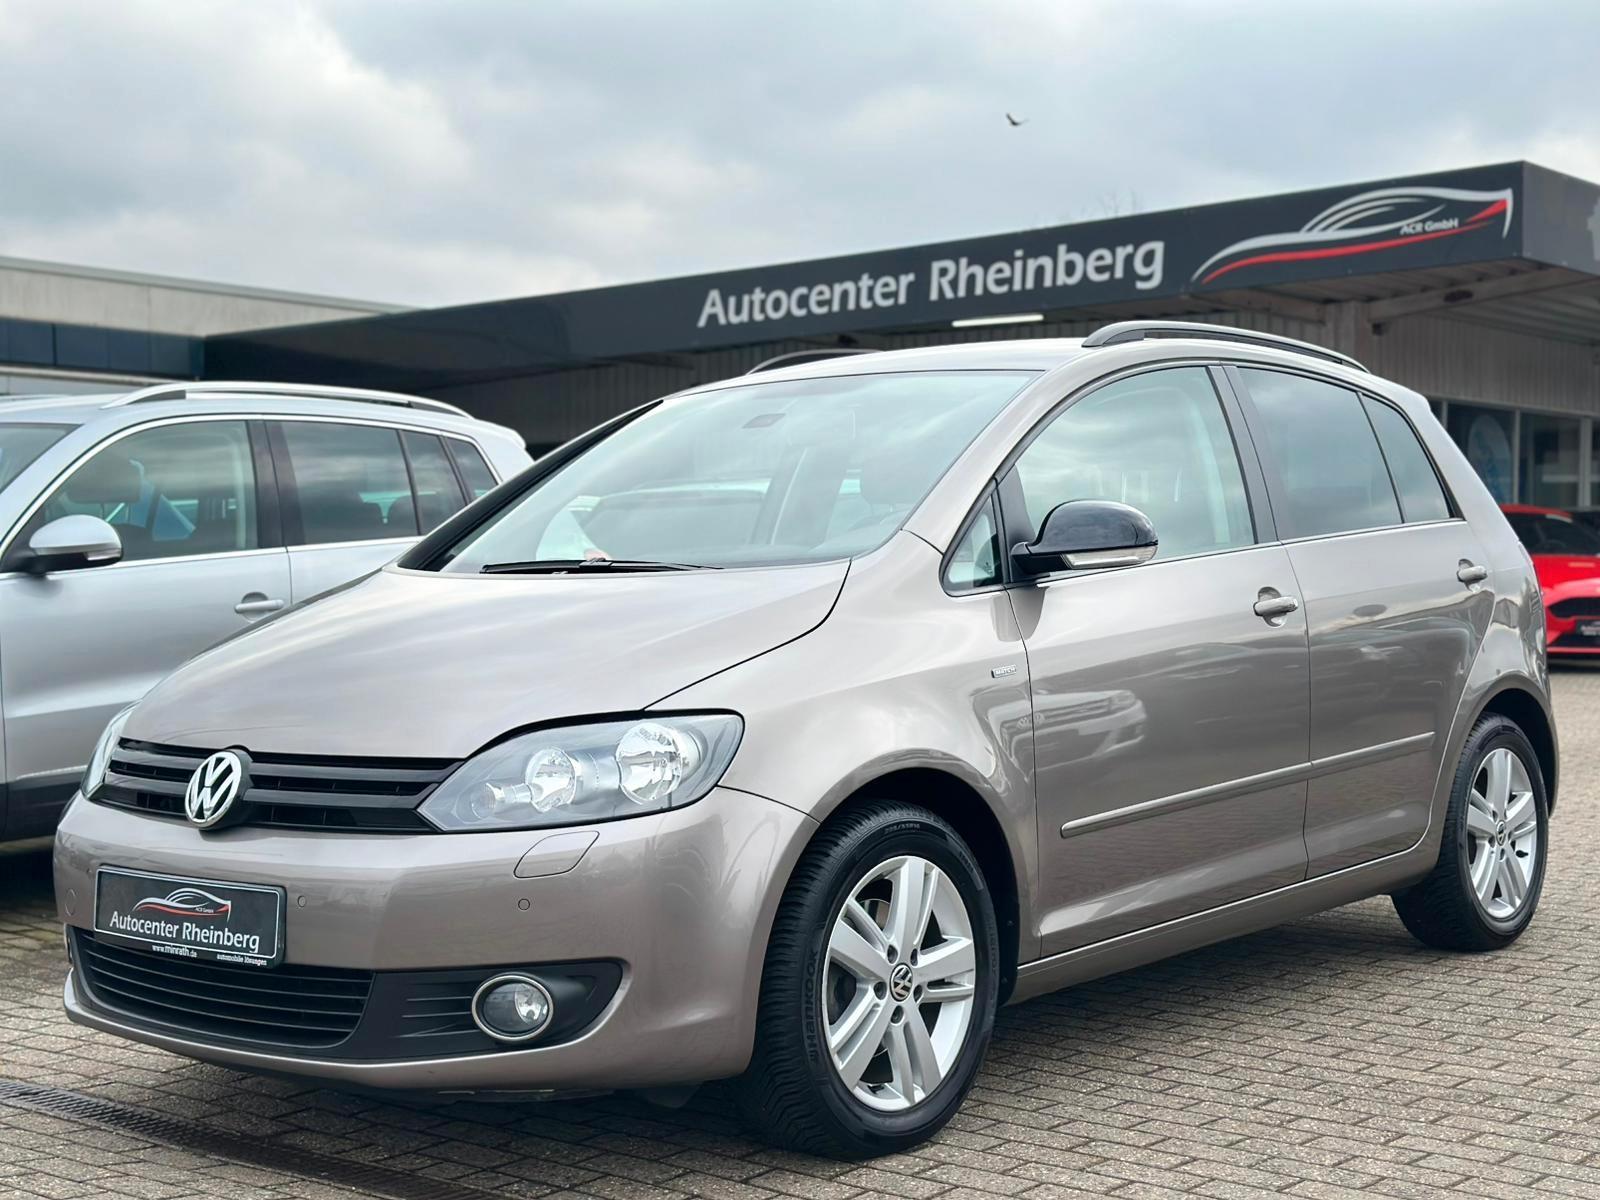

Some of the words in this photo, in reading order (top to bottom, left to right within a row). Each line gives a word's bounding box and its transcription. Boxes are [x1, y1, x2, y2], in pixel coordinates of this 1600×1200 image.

[1400, 222, 1423, 236] ACR
[1424, 217, 1459, 232] GmbH
[697, 272, 915, 328] Autocenter
[929, 240, 1165, 301] Rheinberg
[109, 911, 179, 938] Autocenter
[182, 922, 260, 953] Rheinberg
[152, 944, 198, 958] www.minrath.de
